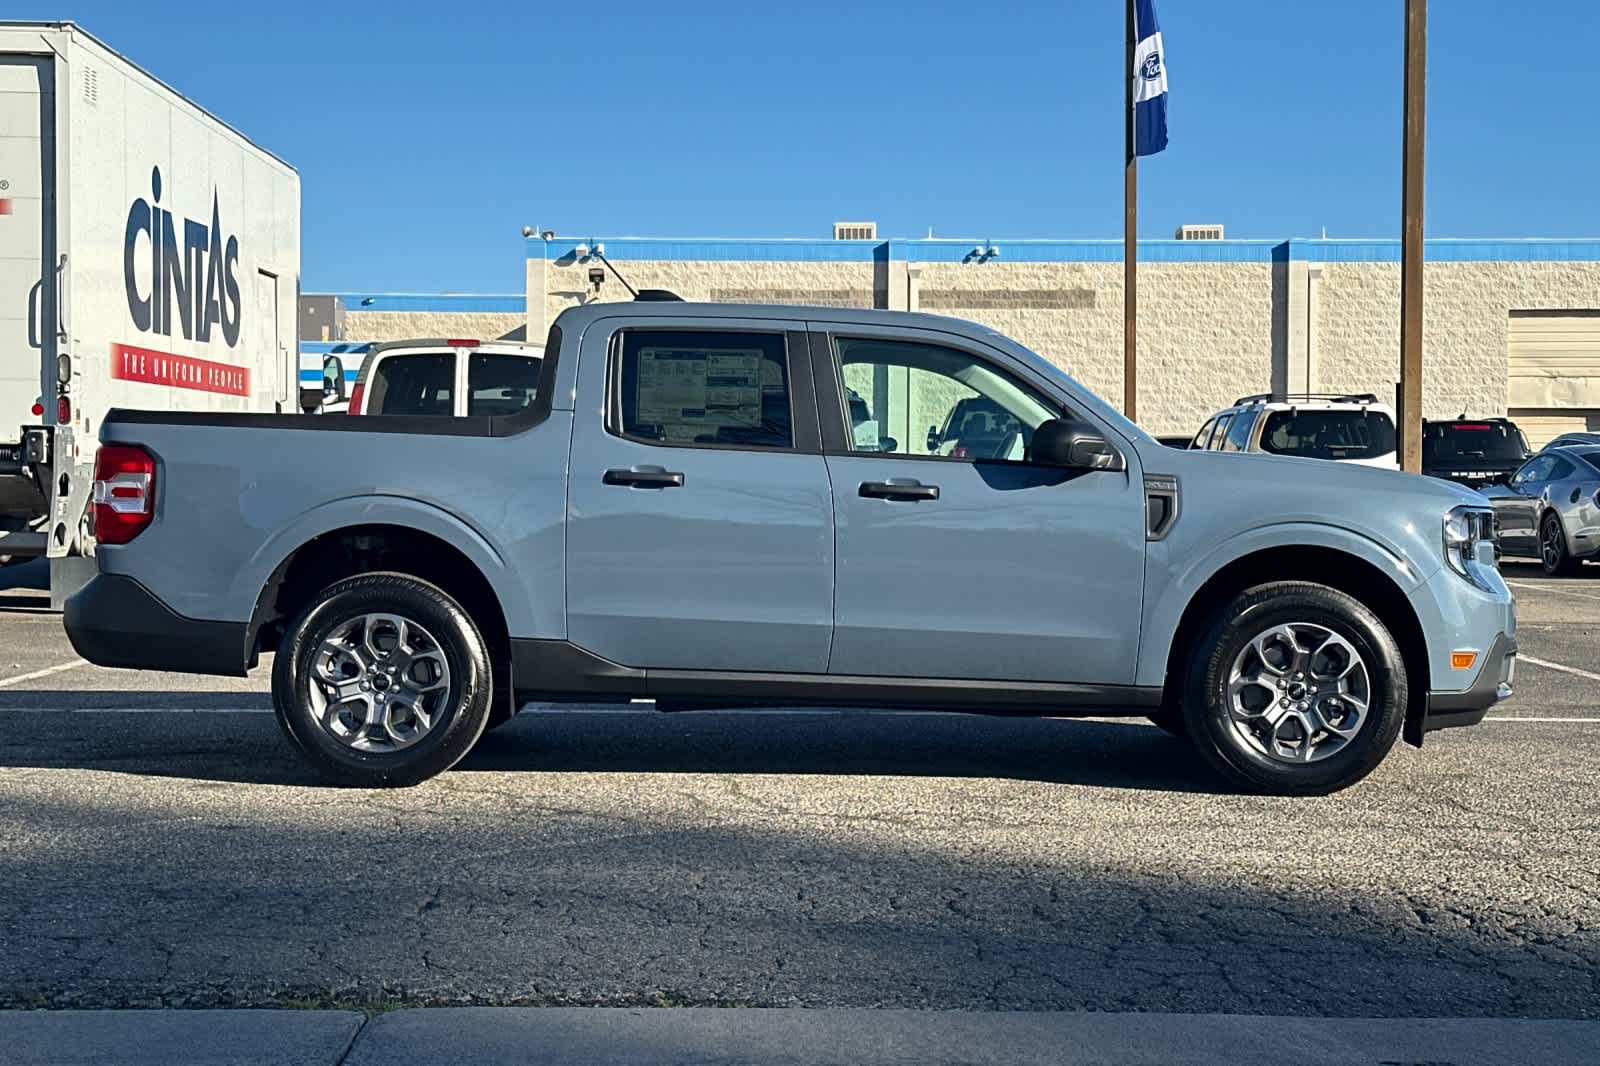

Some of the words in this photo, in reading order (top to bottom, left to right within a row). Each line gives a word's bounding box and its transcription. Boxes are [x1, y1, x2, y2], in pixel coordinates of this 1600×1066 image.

[124, 353, 145, 375] THE
[154, 358, 202, 384] UNIFORM
[209, 367, 243, 390] PEOPLE
